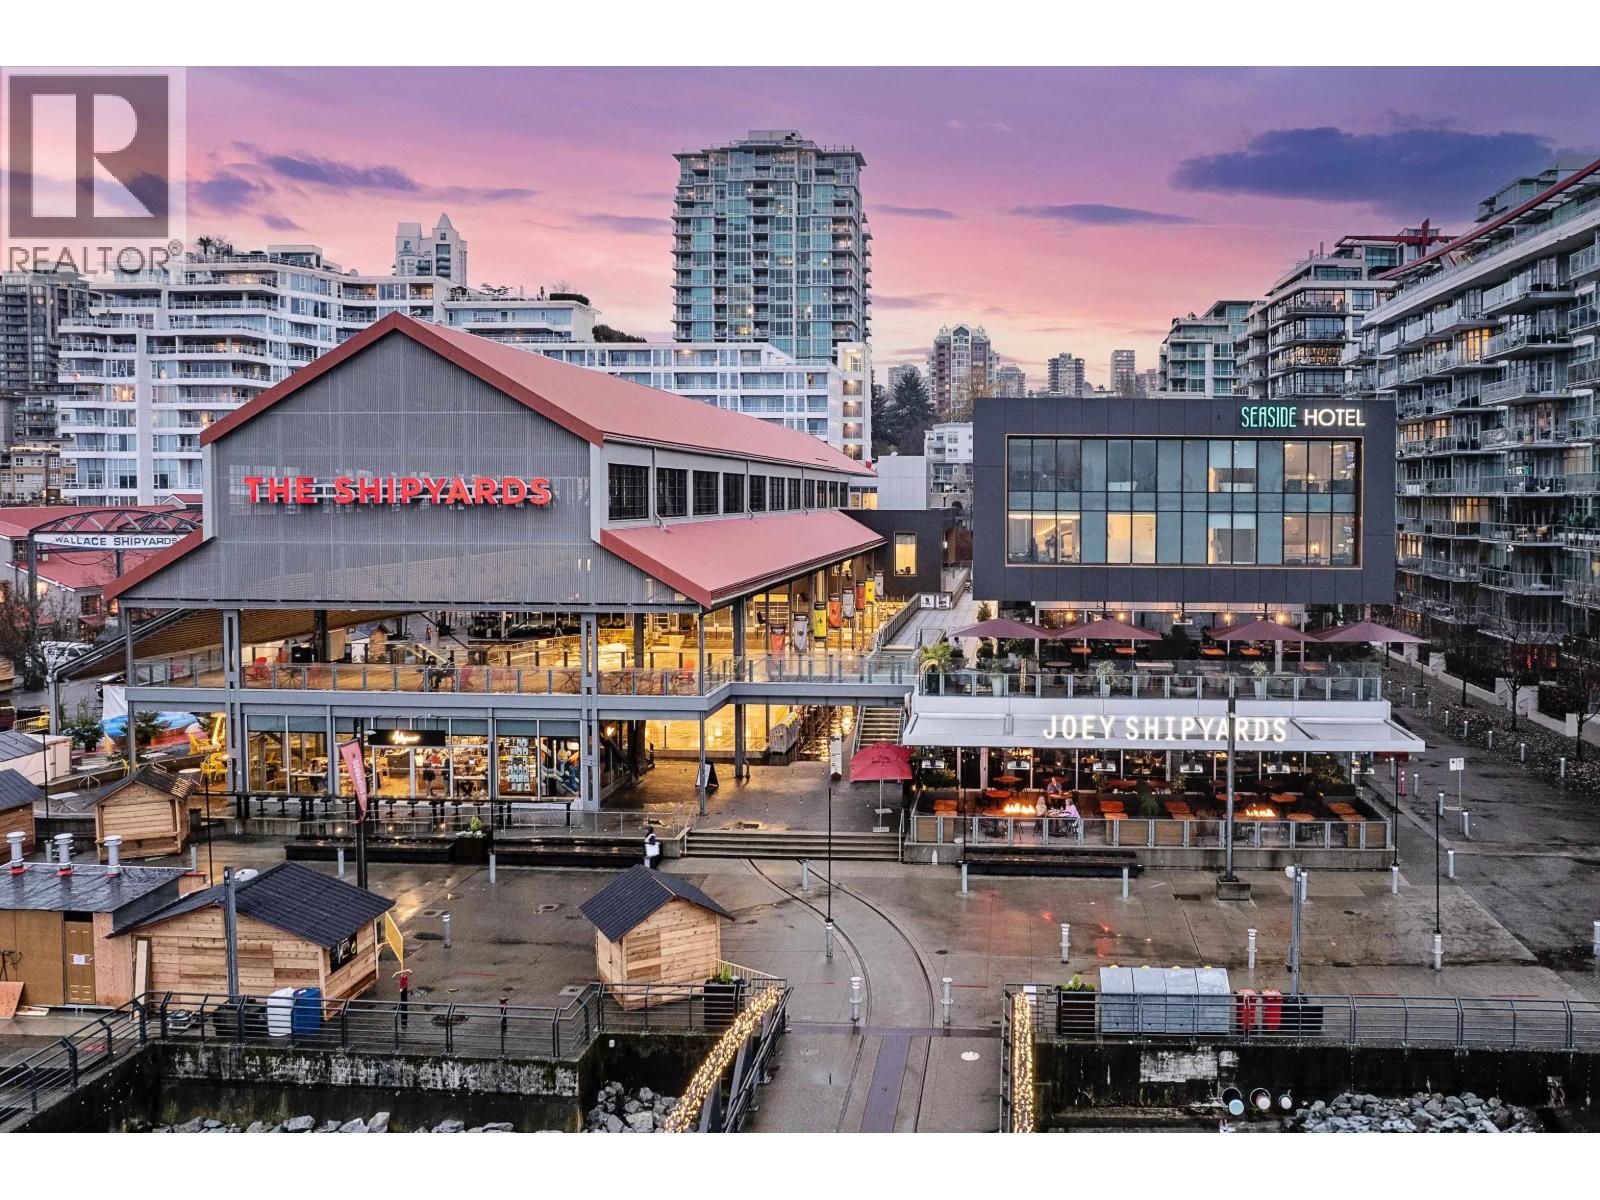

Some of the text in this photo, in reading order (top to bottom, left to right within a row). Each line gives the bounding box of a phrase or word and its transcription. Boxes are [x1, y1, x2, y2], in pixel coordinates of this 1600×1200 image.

[1241, 406, 1366, 428] SEASIDE HOTEL
[243, 476, 552, 506] THE SHIPYARDS
[55, 536, 178, 546] WALLACE SHIPYARDS
[1043, 715, 1288, 743] JOEY SHIPYARDS
